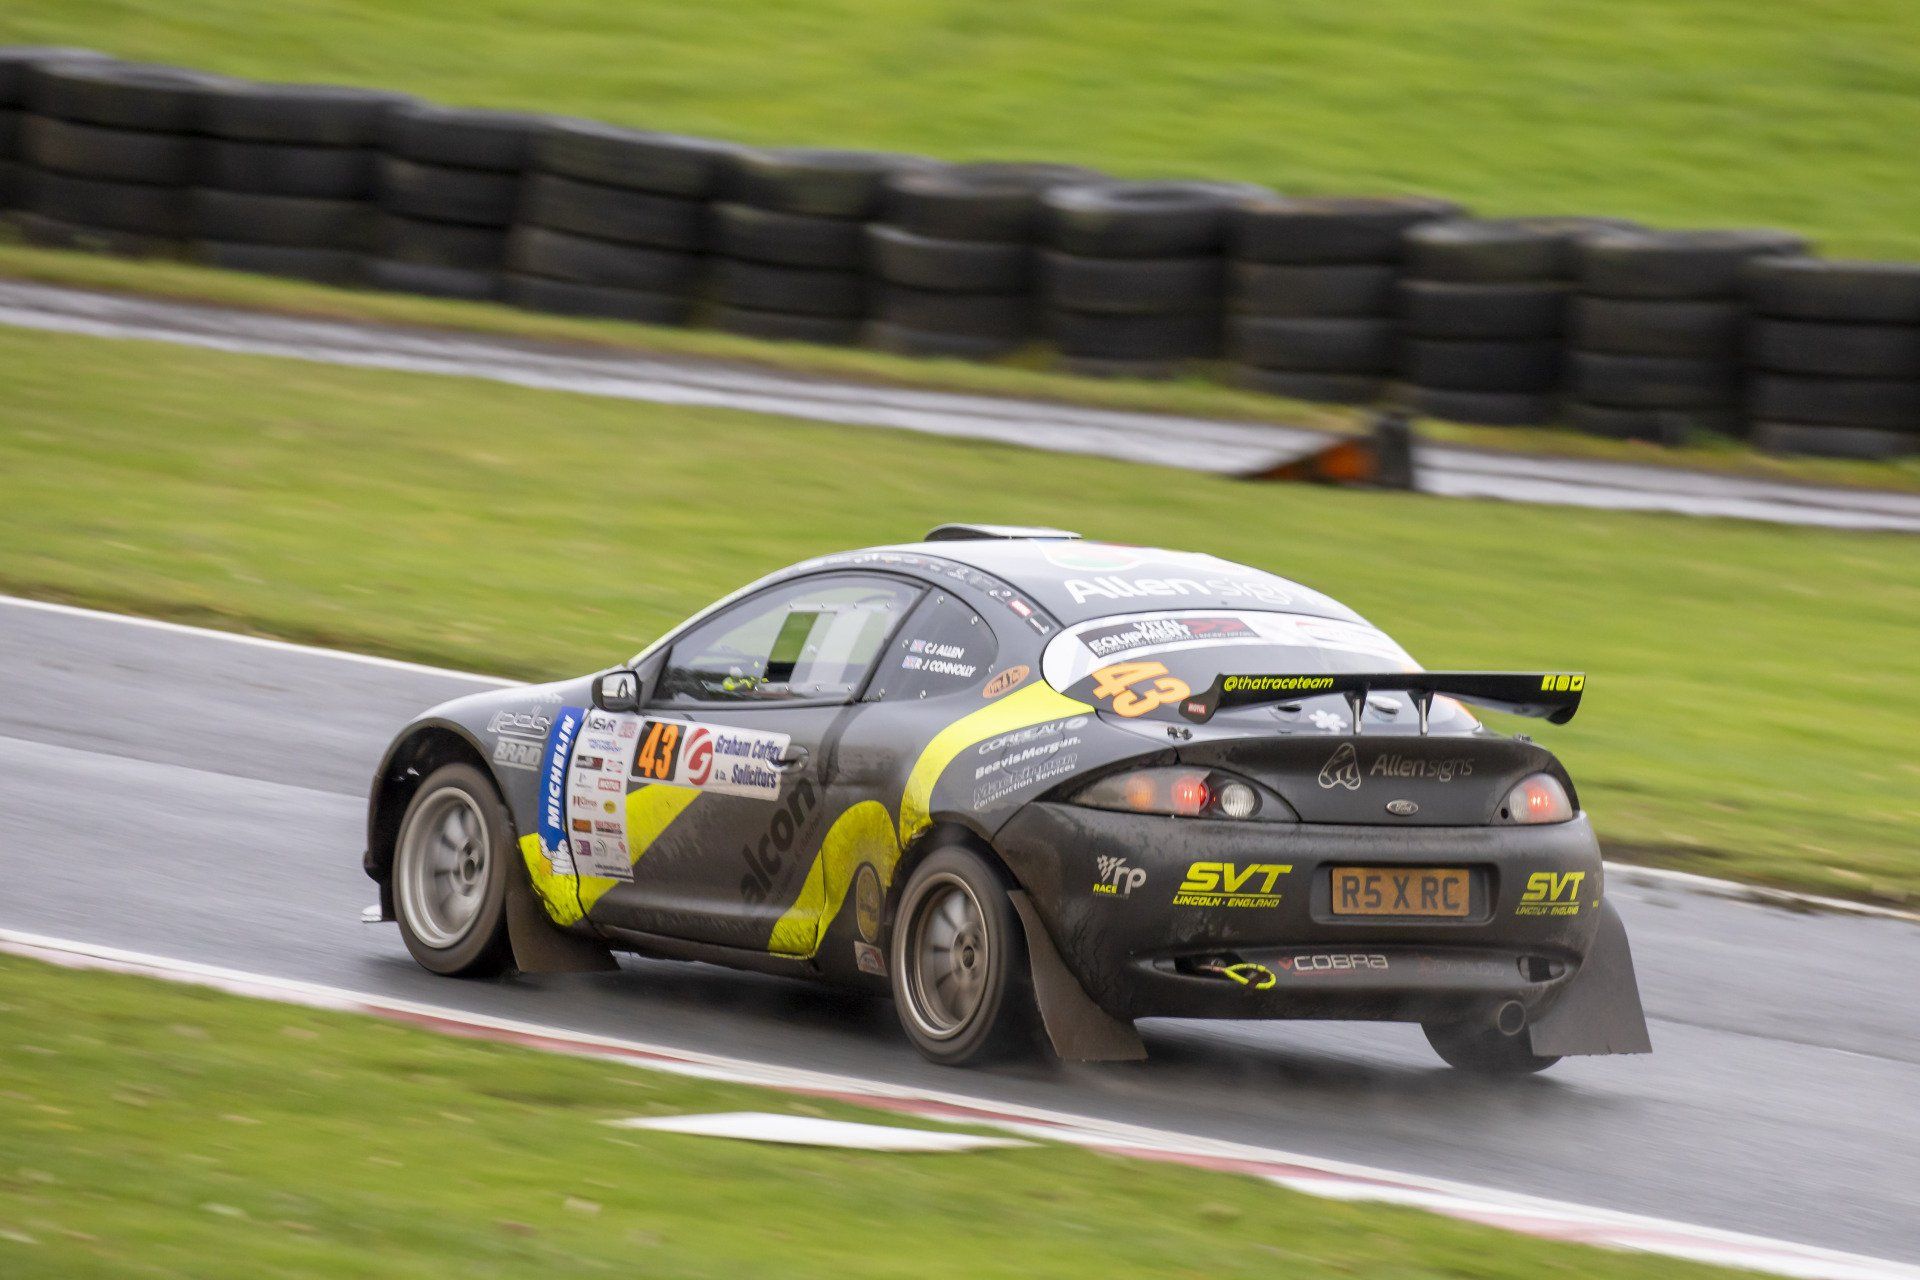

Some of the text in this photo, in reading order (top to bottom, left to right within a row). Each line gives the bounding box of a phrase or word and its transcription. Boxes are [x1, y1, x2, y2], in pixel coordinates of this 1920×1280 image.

[936, 644, 965, 659] ALLEN
[922, 659, 930, 671] J
[929, 659, 977, 678] CONNOLLY
[1092, 661, 1191, 718] 43
[1223, 675, 1334, 691] @thatraceteam
[637, 721, 680, 780] 43
[714, 733, 752, 757] Graham
[548, 714, 575, 830] MICHELIN
[731, 764, 777, 789] Solicitors
[973, 778, 1033, 810] Construction
[1035, 763, 1076, 782] Services
[740, 777, 816, 904] alcon
[1093, 884, 1118, 894] RACE
[1179, 861, 1294, 894] SVT
[1522, 871, 1586, 901] SVT
[1172, 894, 1280, 908] LINCOLN ENGLAND
[1341, 875, 1382, 910] R5
[1421, 875, 1461, 911] RC
[1514, 904, 1580, 916] LINCOLN ENGLAND
